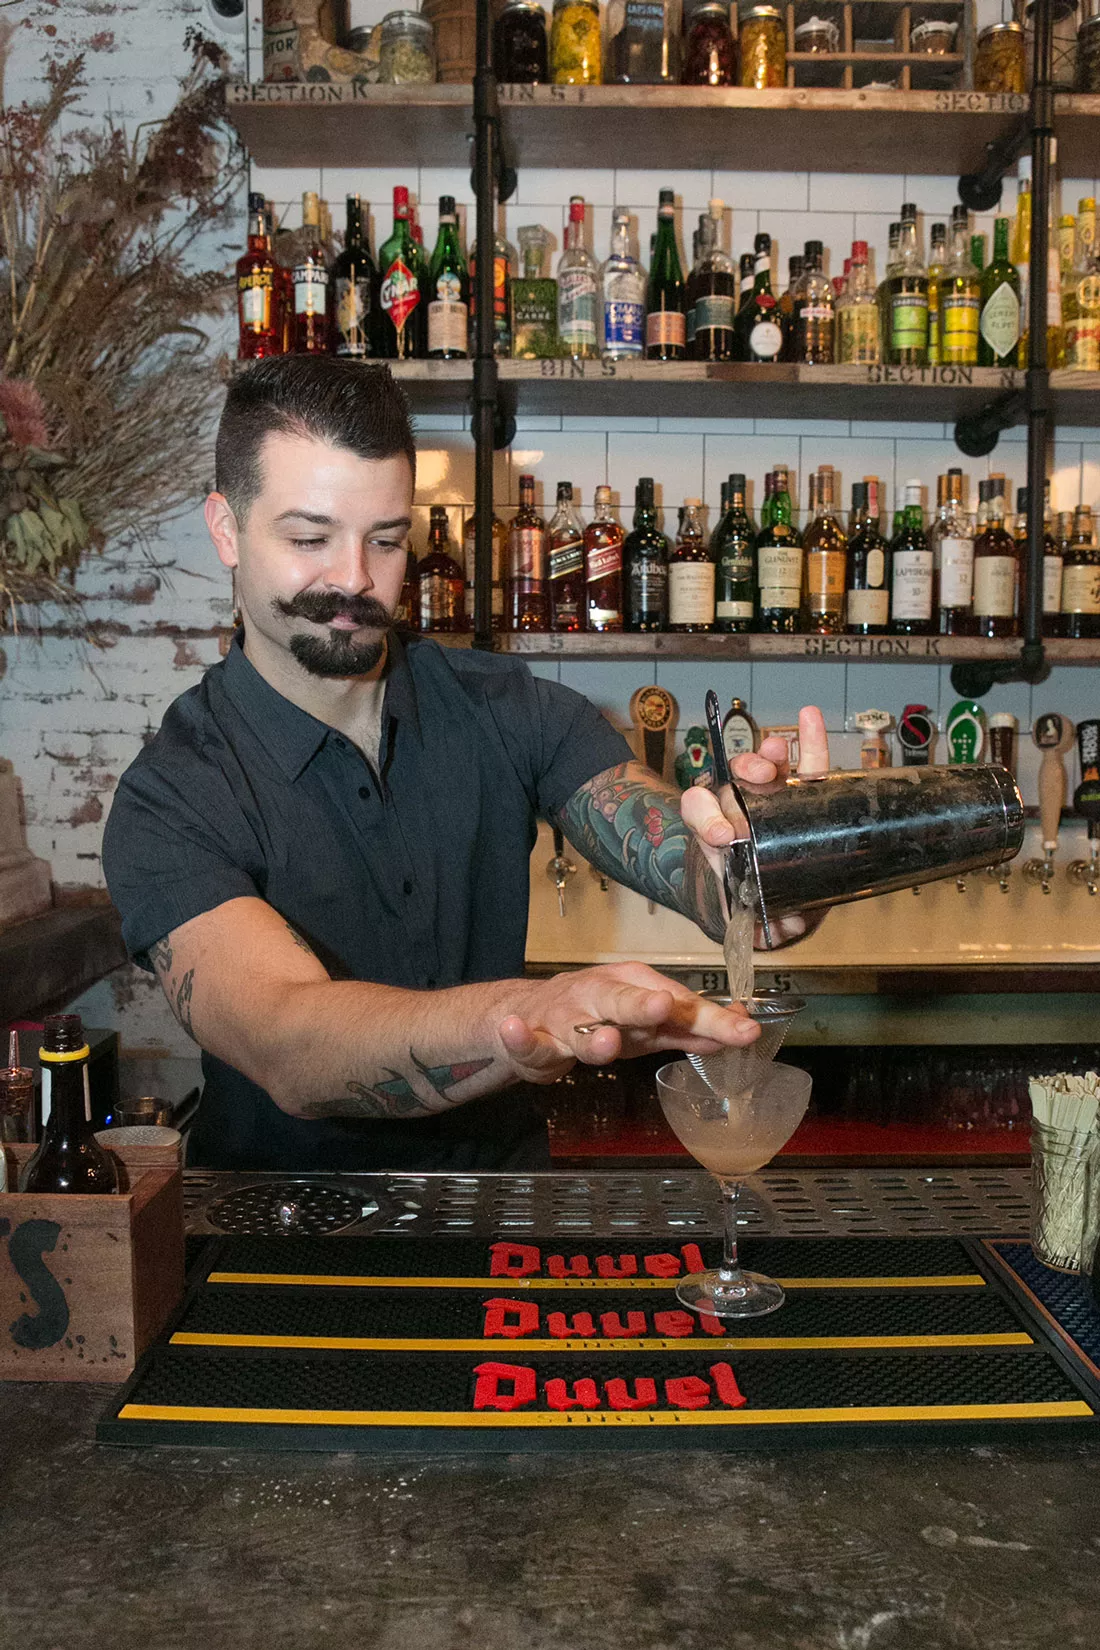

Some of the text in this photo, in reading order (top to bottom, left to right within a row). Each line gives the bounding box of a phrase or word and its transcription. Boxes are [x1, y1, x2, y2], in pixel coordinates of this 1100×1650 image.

[234, 84, 343, 102] SECTION
[936, 92, 1025, 112] SECTIO
[541, 359, 585, 378] BIN
[867, 364, 973, 385] SECTION
[804, 638, 940, 656] SECTION K
[488, 1241, 705, 1278] Duvel
[482, 1297, 727, 1339] Duvel
[473, 1361, 747, 1411] Duvel
